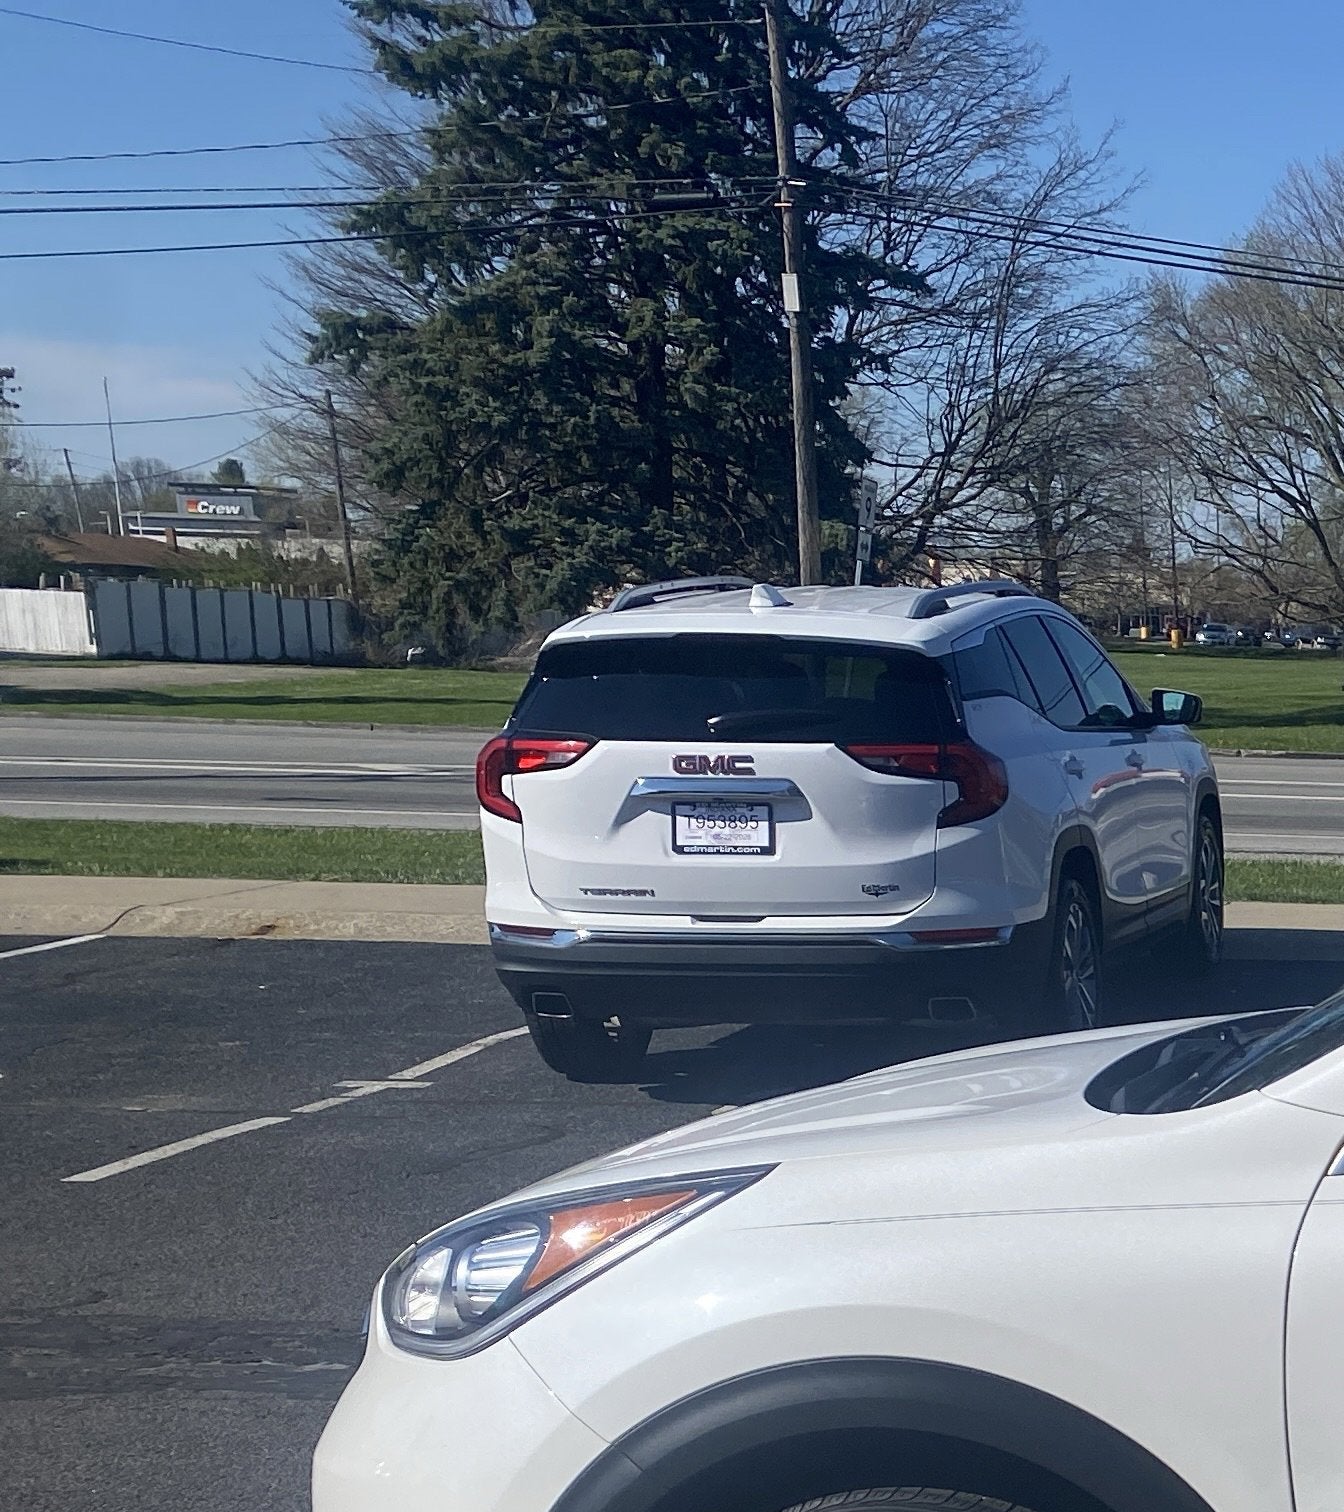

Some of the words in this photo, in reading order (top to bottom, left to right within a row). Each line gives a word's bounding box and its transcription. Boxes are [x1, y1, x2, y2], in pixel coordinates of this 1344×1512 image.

[197, 500, 241, 515] Crew
[672, 754, 757, 776] GMC
[684, 814, 759, 830] T953895
[683, 845, 761, 854] edmartin.com
[578, 887, 657, 898] TERRAIN
